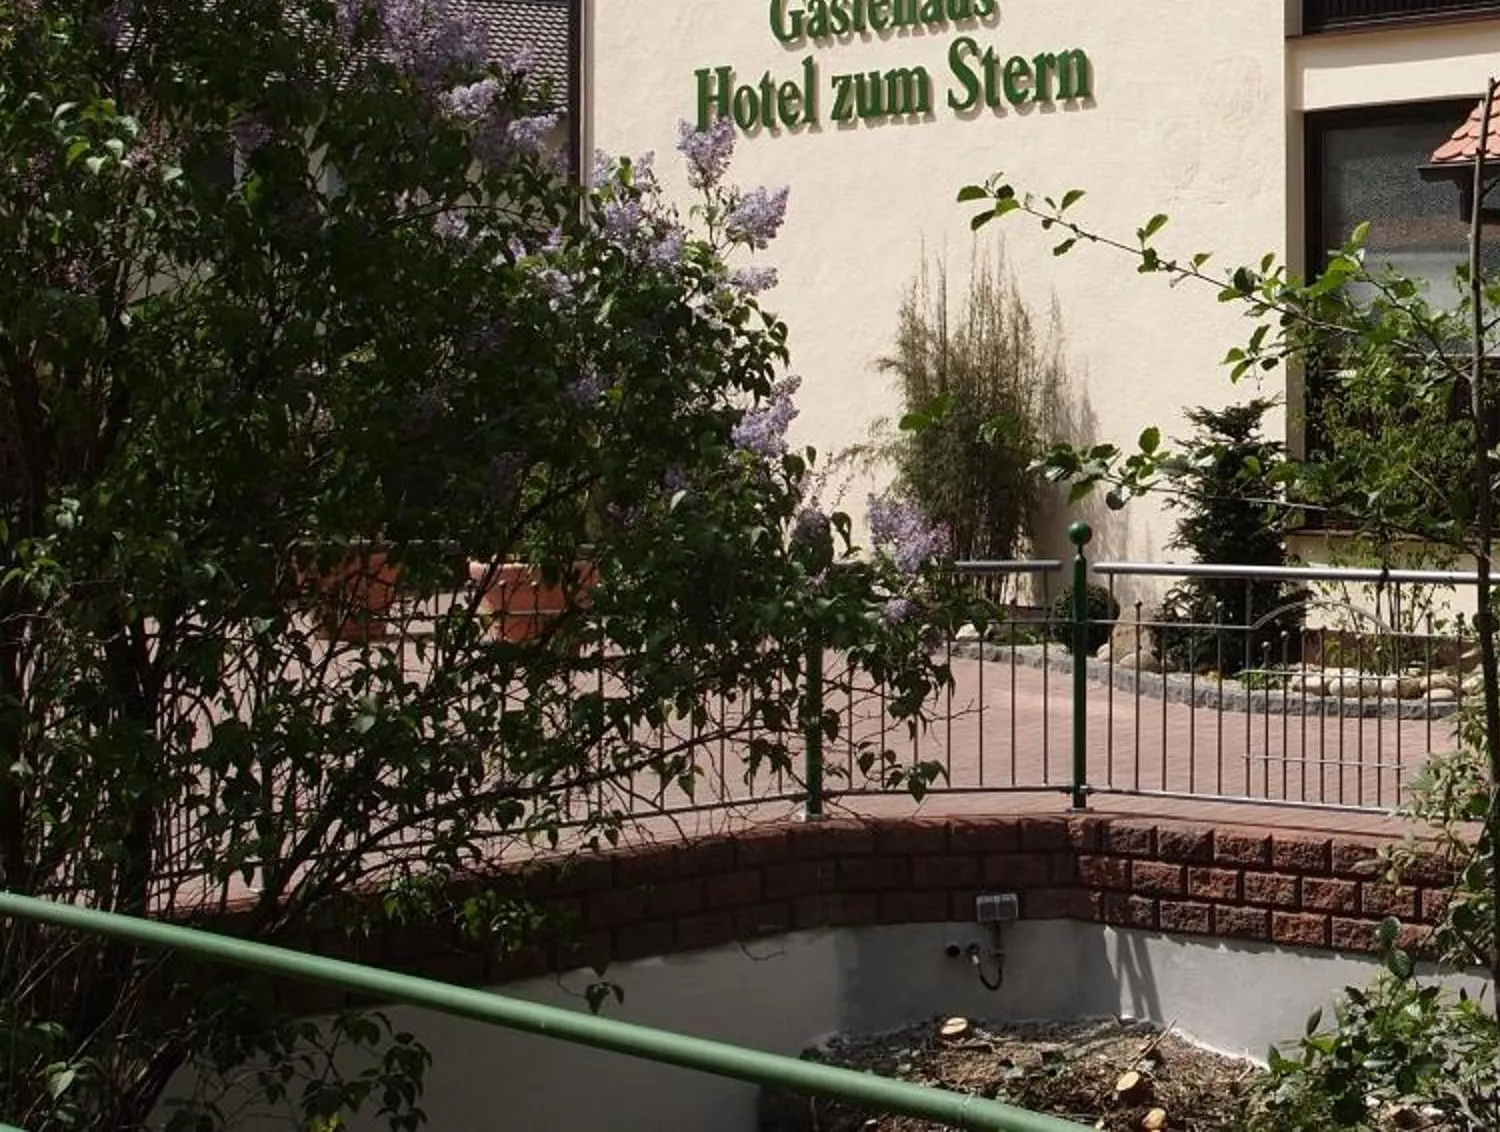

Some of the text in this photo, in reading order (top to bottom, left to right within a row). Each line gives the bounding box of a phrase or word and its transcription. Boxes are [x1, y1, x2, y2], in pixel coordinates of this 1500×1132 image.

[694, 36, 1092, 131] Hotel zum Stern
